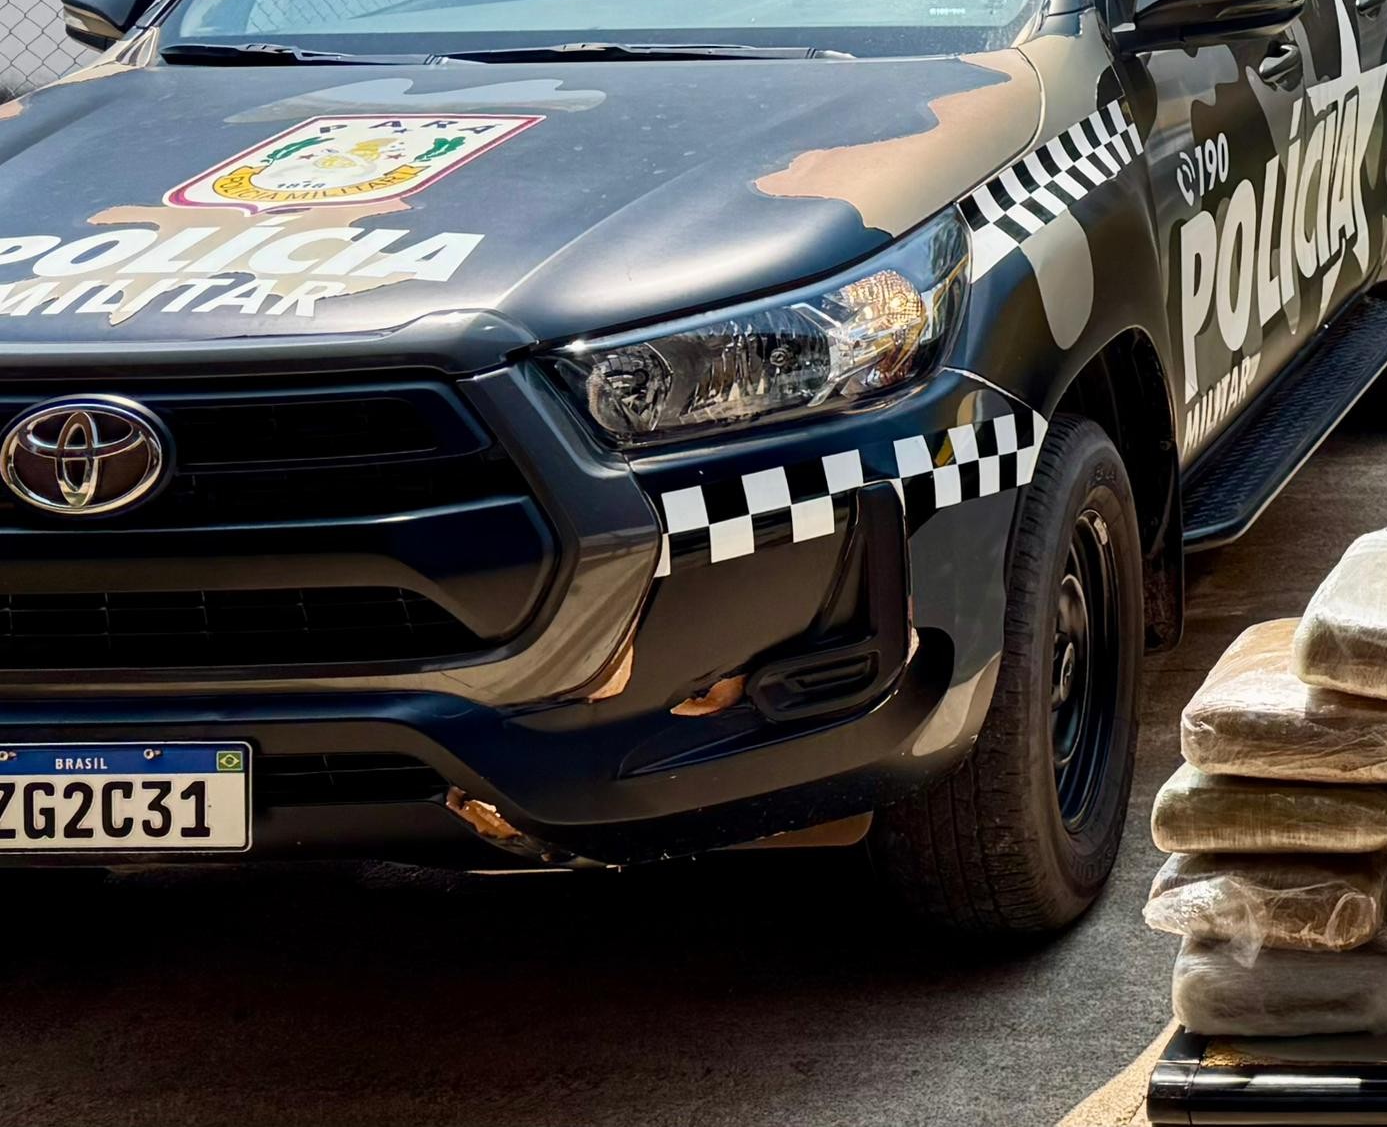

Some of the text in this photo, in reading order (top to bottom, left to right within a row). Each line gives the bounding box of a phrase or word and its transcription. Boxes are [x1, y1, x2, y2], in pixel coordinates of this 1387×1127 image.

[1195, 133, 1229, 197] 190
[1181, 95, 1360, 404] POLÍCIA
[1181, 356, 1252, 460] MILITAR
[55, 758, 108, 770] BRASIL
